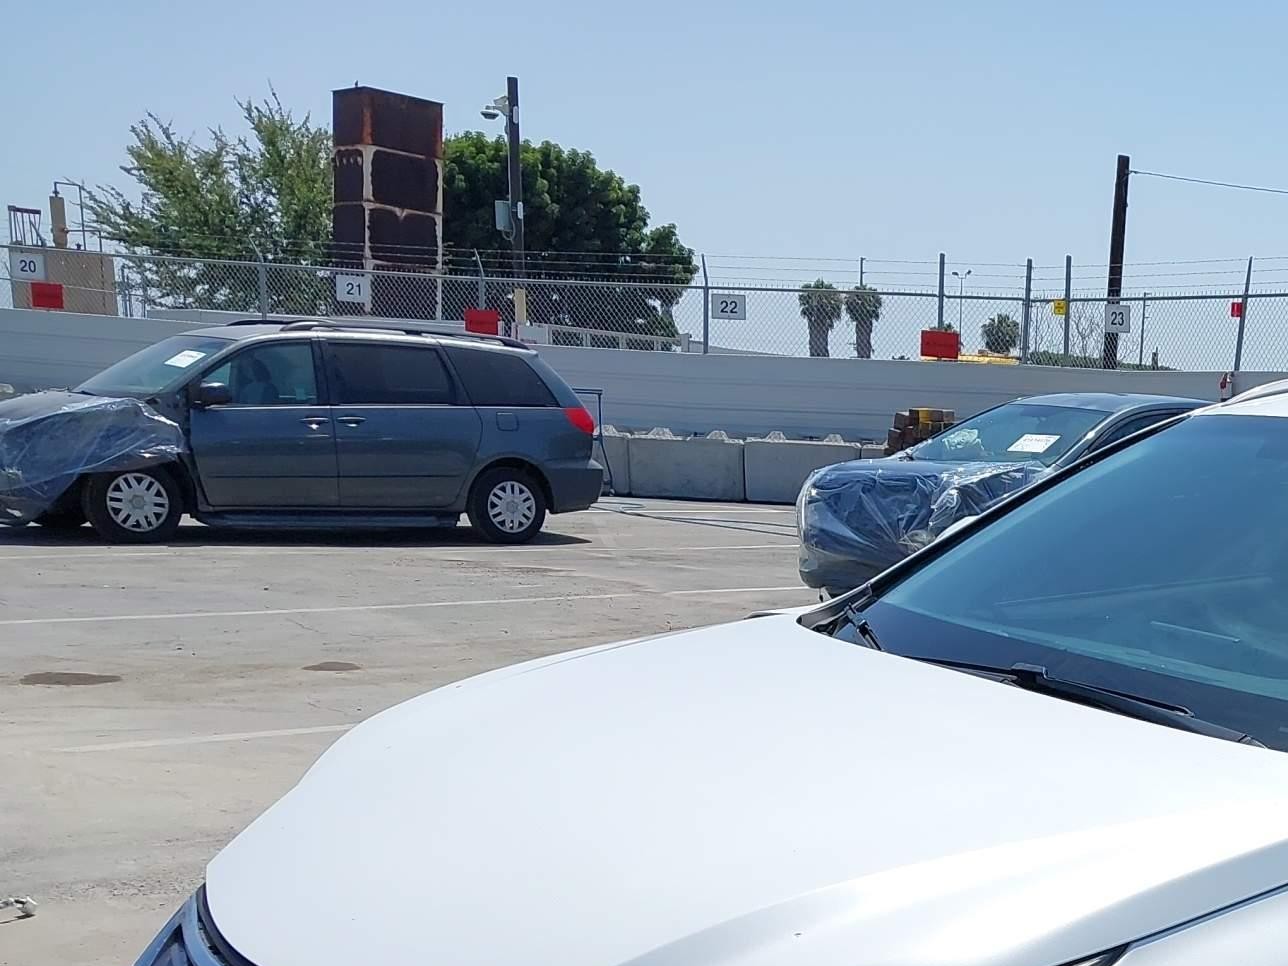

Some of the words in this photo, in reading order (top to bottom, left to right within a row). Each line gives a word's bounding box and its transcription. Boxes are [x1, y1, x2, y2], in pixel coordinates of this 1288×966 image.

[20, 260, 36, 273] 20
[346, 283, 362, 296] 21
[720, 301, 738, 314] 22
[1111, 312, 1125, 326] 23
